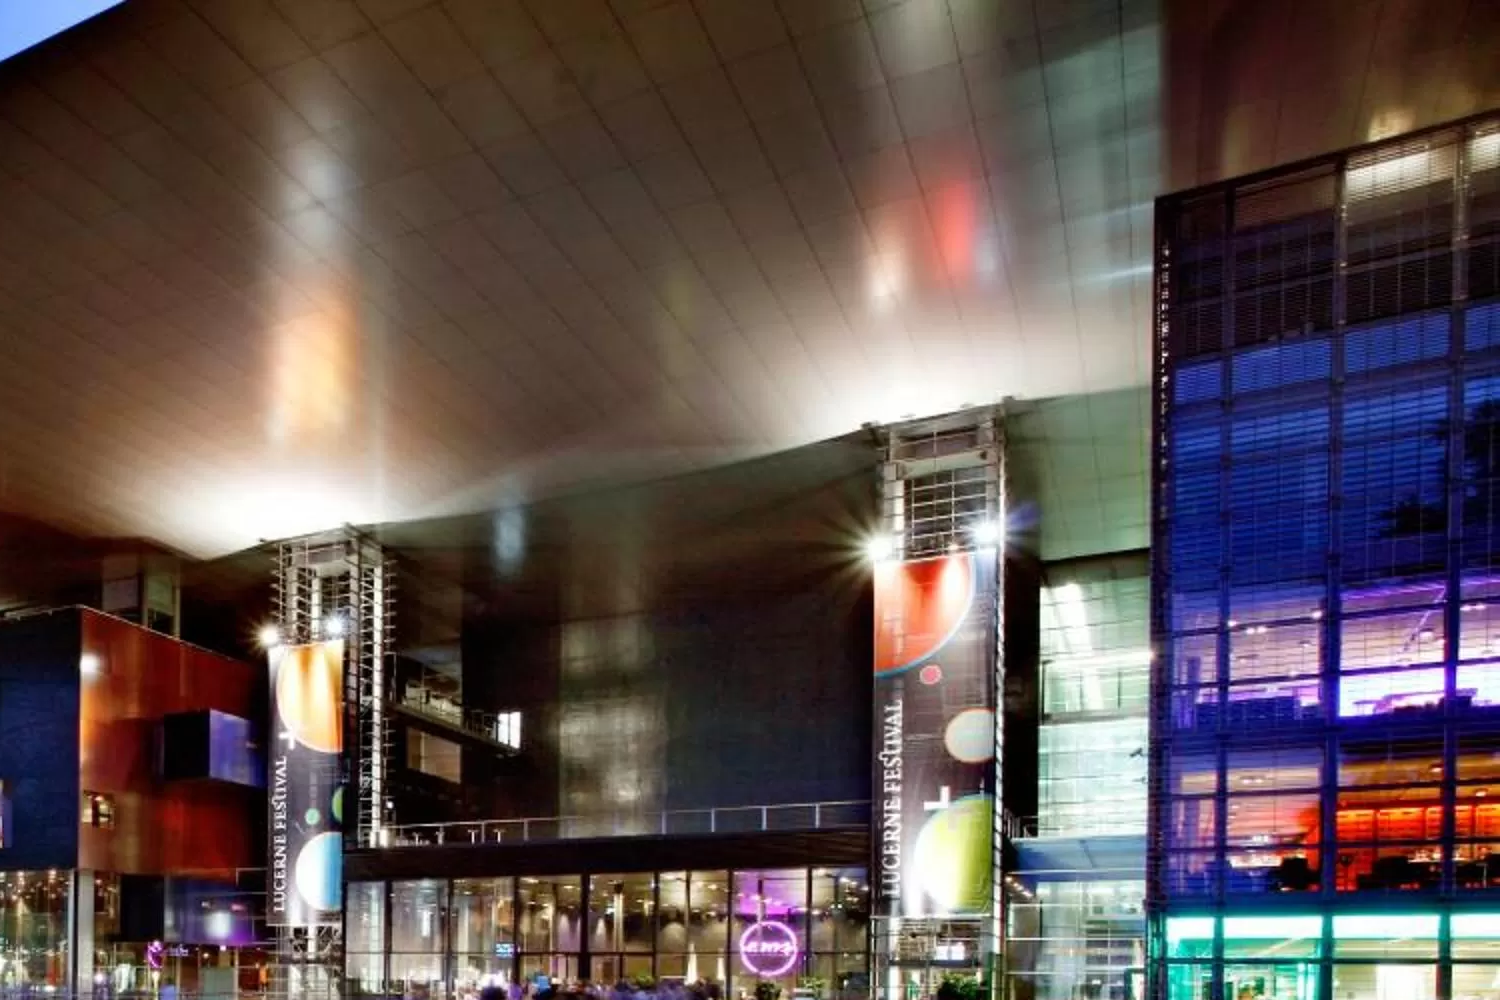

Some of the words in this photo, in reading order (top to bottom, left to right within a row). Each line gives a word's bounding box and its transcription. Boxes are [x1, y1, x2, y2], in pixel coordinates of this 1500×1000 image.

[879, 699, 903, 793] FESTIVAL
[271, 755, 287, 831] FESTIVAL
[272, 834, 287, 912] LUCERNE
[881, 796, 902, 897] LUCERNE
